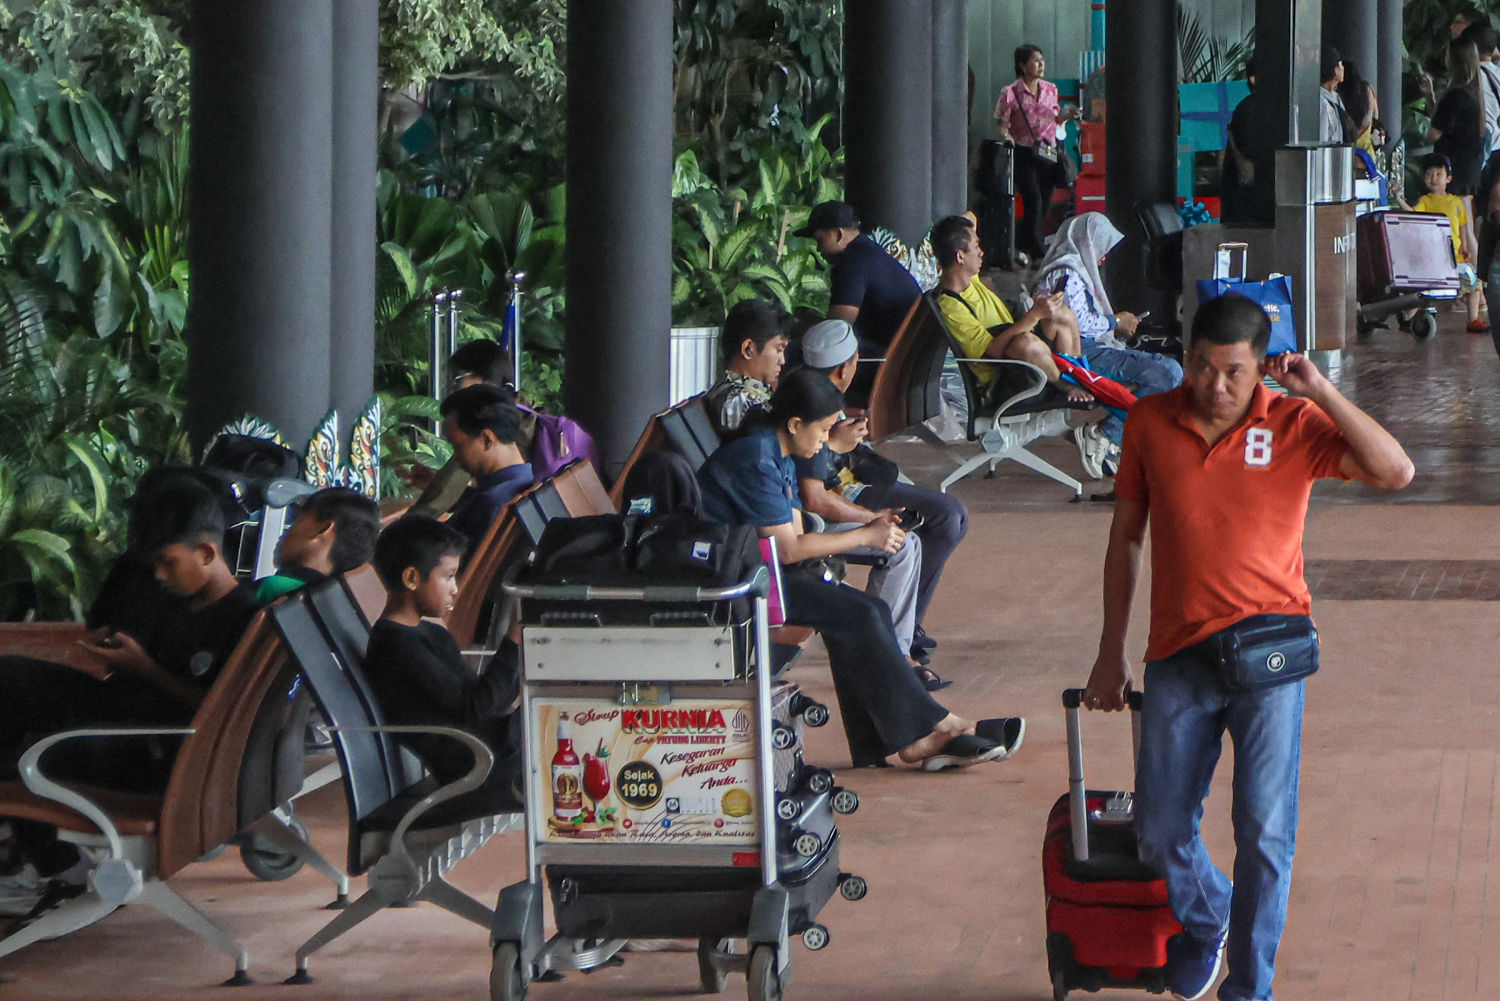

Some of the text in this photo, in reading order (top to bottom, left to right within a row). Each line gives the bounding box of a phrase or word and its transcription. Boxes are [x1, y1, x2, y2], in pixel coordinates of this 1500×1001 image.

[1244, 426, 1273, 466] 8
[621, 708, 727, 731] KURNIA
[659, 747, 726, 765] Kesegaran
[623, 769, 655, 781] Sejak
[681, 758, 738, 778] Keluarga
[621, 783, 658, 798] 1969
